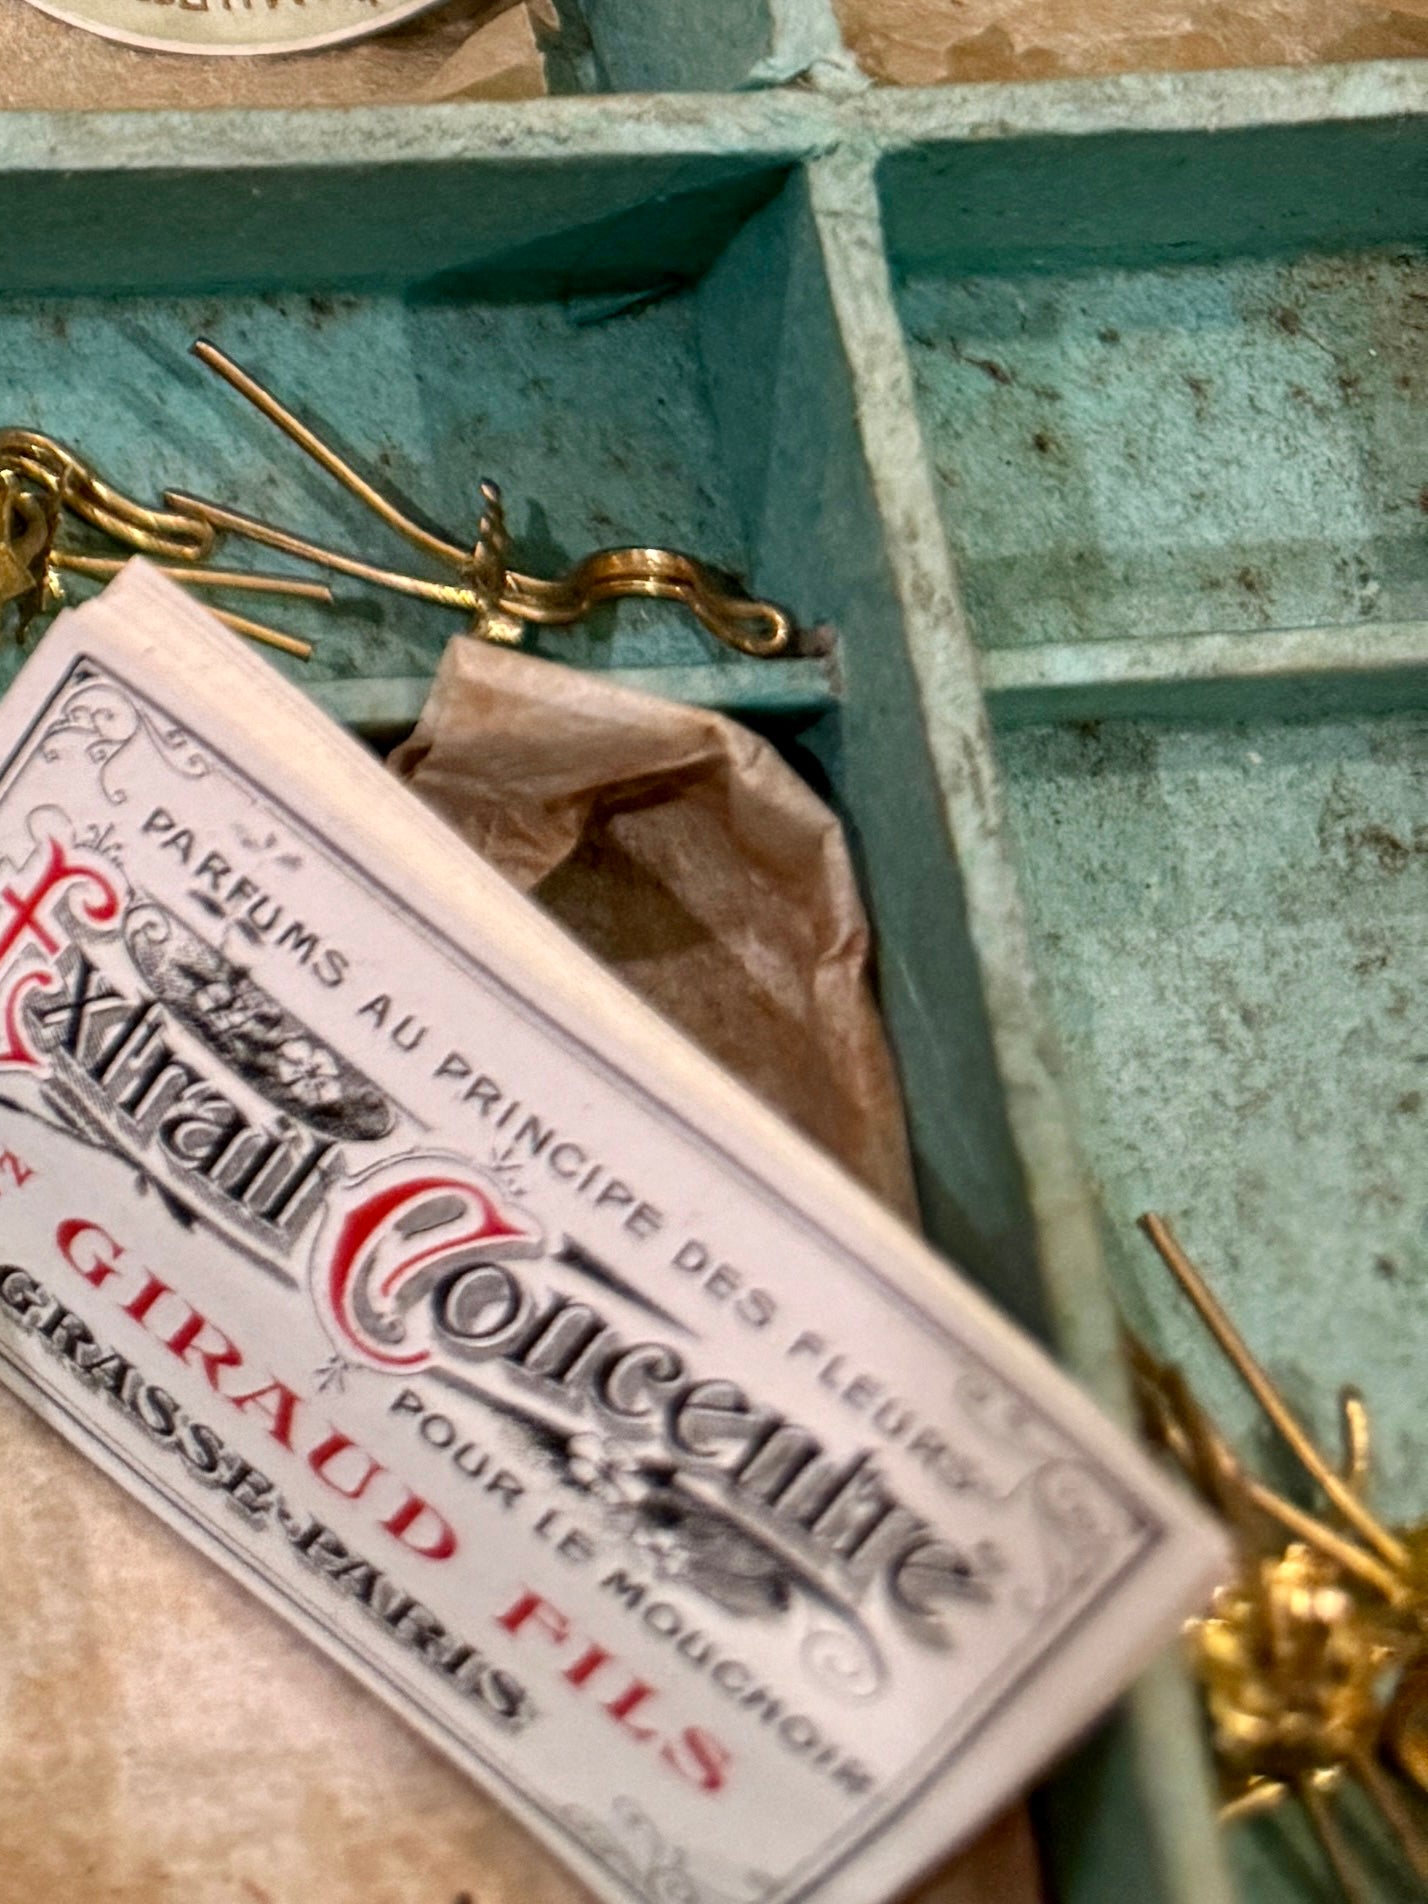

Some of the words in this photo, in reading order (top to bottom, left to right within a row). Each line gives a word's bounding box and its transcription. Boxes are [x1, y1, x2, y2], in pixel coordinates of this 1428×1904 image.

[142, 806, 351, 990] PARFUMS
[358, 993, 430, 1053] AU
[434, 1052, 664, 1237] PRINCIPE
[670, 1238, 780, 1330] DES
[55, 1215, 461, 1563] GIRAUD
[496, 1590, 733, 1794] FILS
[389, 1389, 527, 1510] POUR
[534, 1508, 599, 1563] LE
[600, 1569, 873, 1794] MOUCHOIR
